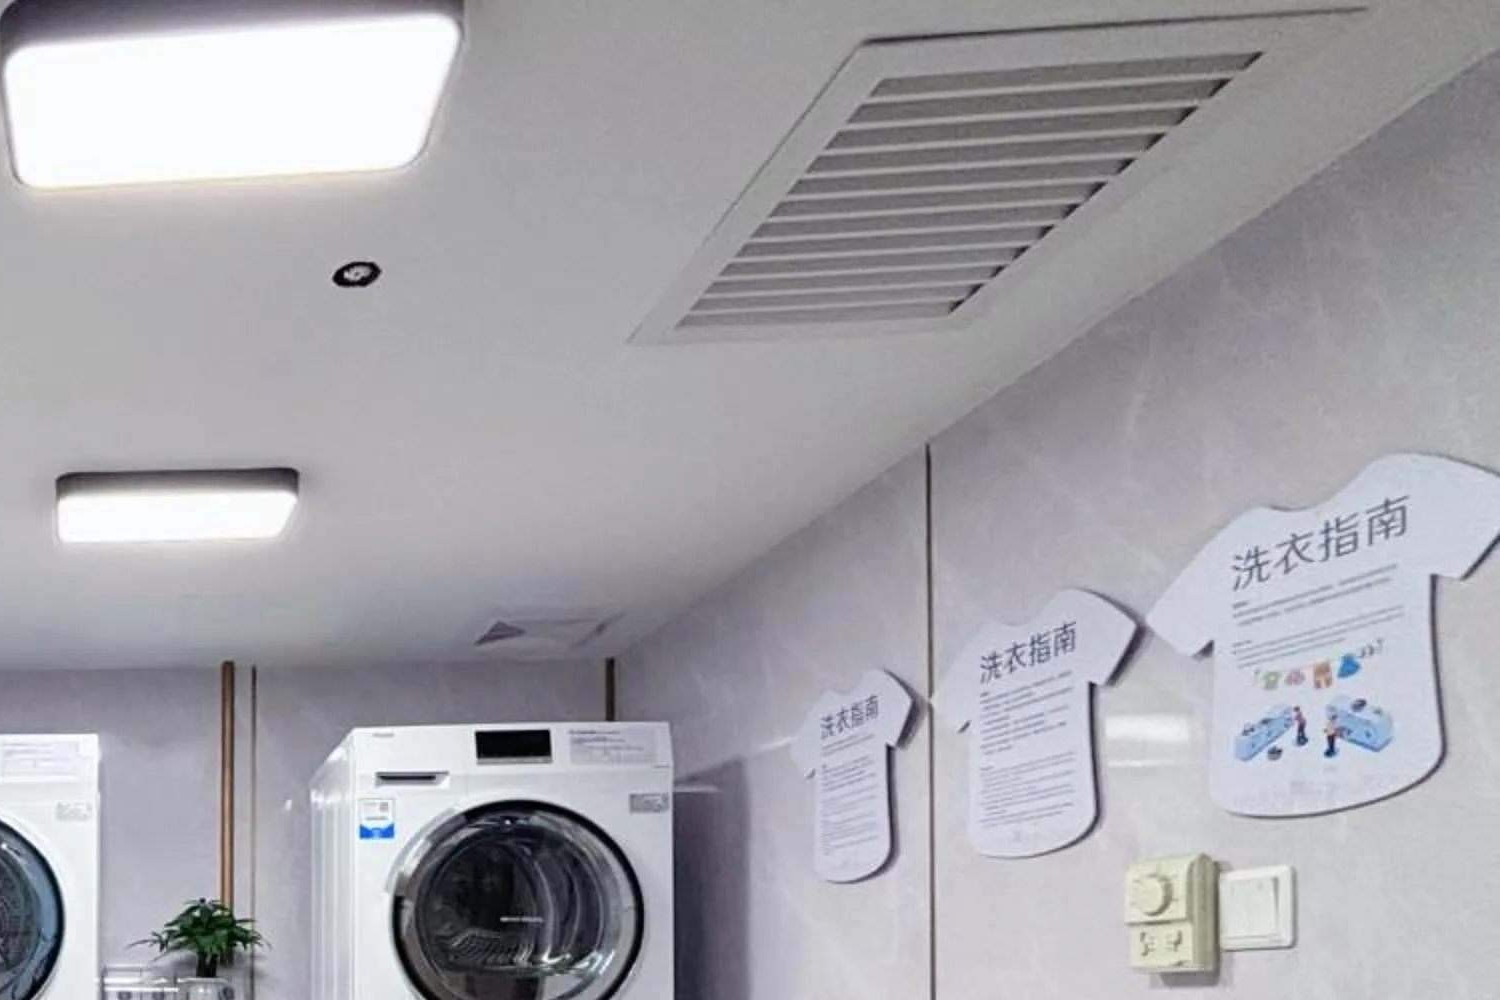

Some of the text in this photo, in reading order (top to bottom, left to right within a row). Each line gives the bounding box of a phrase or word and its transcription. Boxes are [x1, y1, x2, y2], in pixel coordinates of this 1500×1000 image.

[1231, 495, 1410, 592] 洗衣指南
[980, 621, 1077, 685] 洗衣指南
